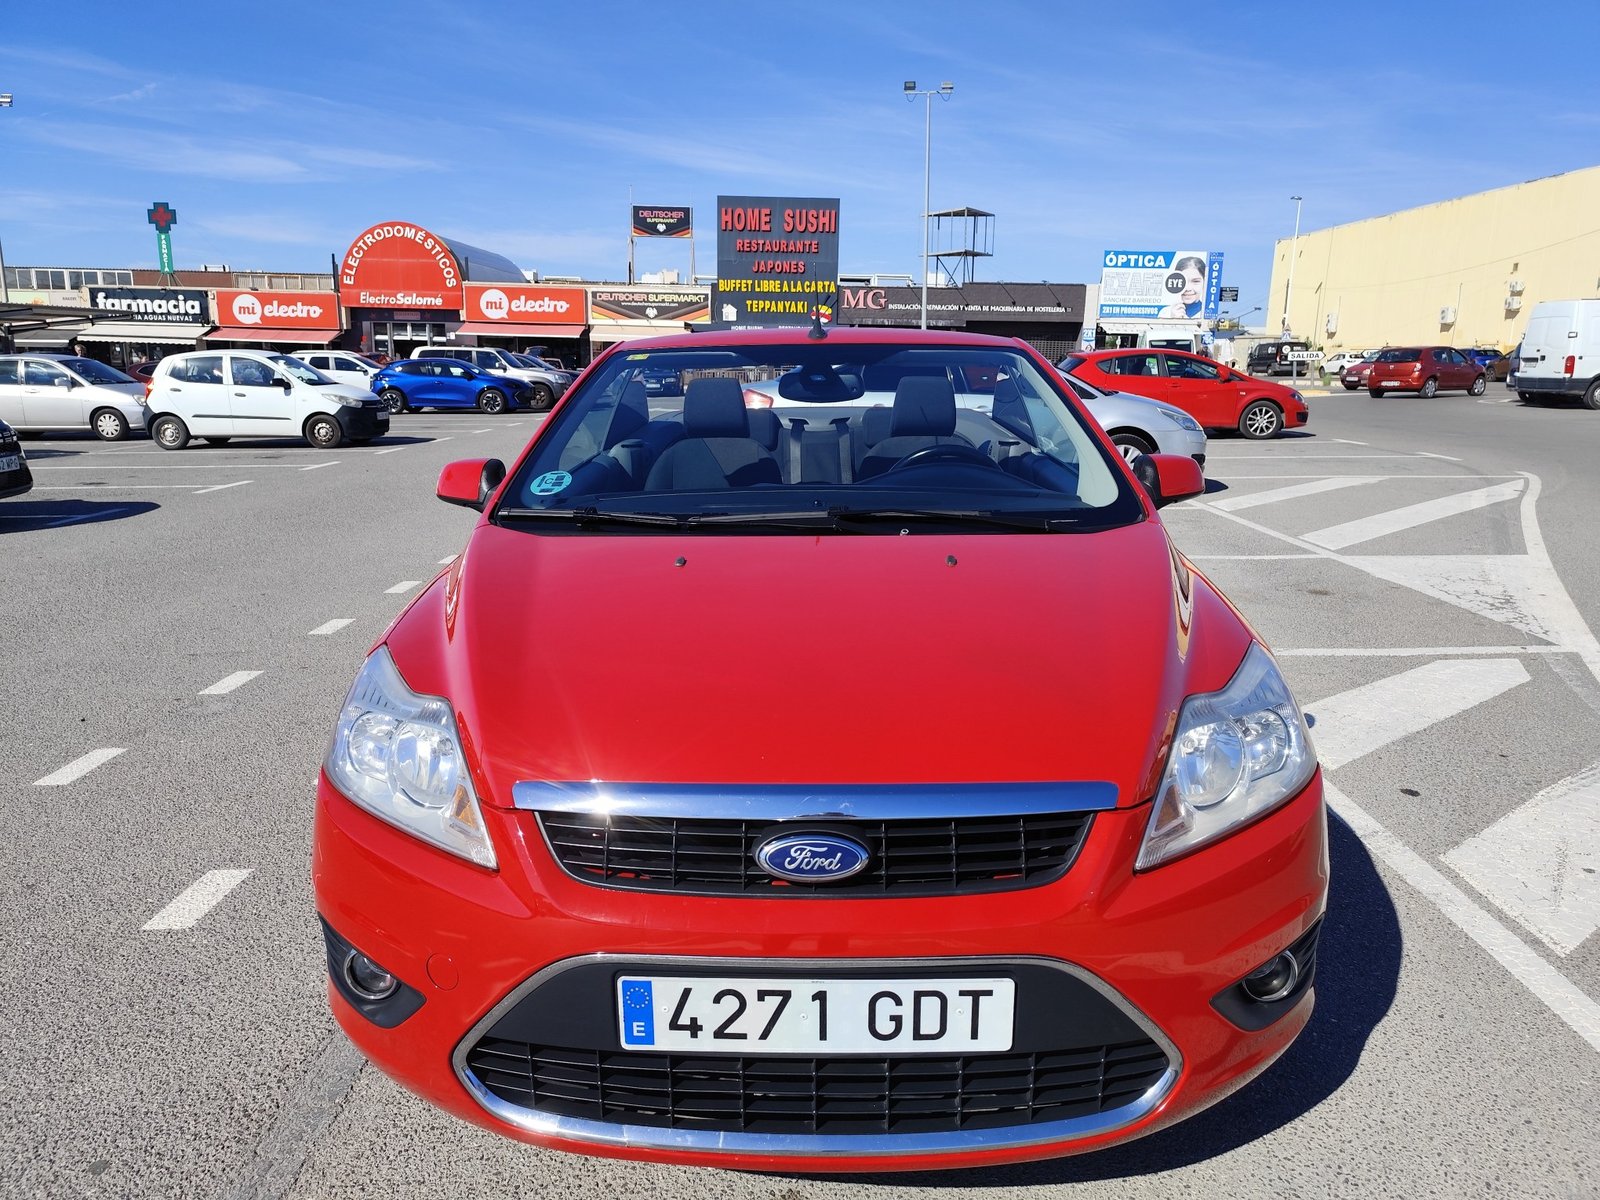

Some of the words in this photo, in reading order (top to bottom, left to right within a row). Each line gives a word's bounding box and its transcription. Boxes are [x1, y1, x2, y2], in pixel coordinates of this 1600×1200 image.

[721, 208, 771, 231] HOME
[783, 209, 836, 233] SUSHI
[161, 234, 169, 272] FARMACIA
[736, 239, 819, 253] RESTAURANTE
[343, 225, 457, 288] ELECTRODOMÉSTICOS
[1105, 252, 1166, 267] ÓPTICA
[752, 260, 805, 274] JAPONES
[719, 279, 752, 292] BUFFET
[755, 280, 780, 292] LIBRE
[782, 281, 789, 292] A
[790, 281, 802, 292] LA
[804, 281, 836, 293] CARTA
[1167, 279, 1183, 287] EYE
[96, 292, 201, 314] farmacia
[360, 291, 443, 306] ElectroSalomé
[485, 298, 504, 310] mi
[510, 295, 570, 313] electro
[597, 293, 647, 301] DEUTSCHER
[648, 294, 705, 303] SUPERMARKT
[746, 300, 808, 313] TEPPANYAKI
[842, 288, 888, 309] MG
[238, 303, 257, 315] mi
[263, 300, 323, 318] electro
[784, 846, 841, 871] Ford
[668, 987, 828, 1042] 4271
[867, 989, 994, 1042] GDT
[632, 1021, 646, 1037] E
